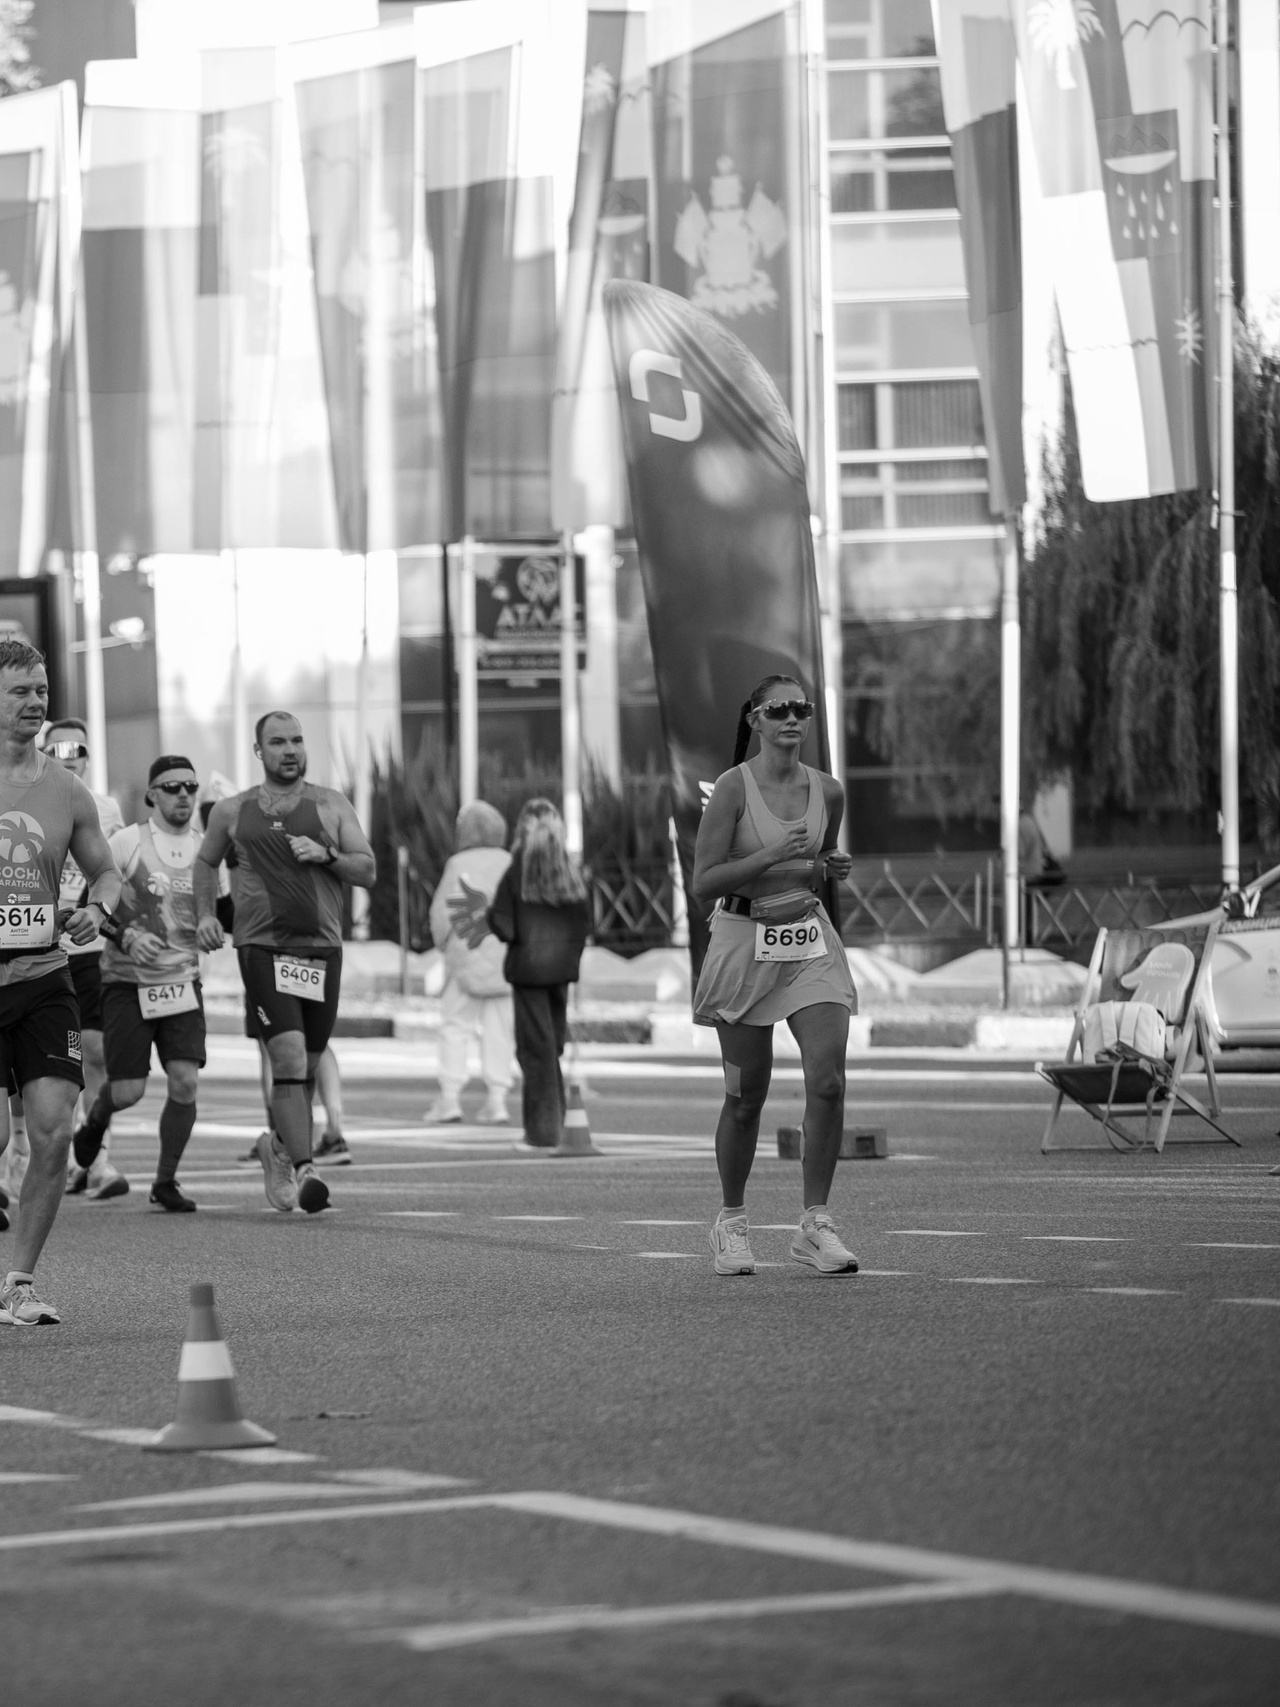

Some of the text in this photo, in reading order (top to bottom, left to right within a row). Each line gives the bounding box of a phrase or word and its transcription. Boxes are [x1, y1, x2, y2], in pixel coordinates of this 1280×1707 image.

[764, 925, 818, 946] 6690
[280, 964, 320, 985] 6406
[148, 984, 185, 1002] 6417
